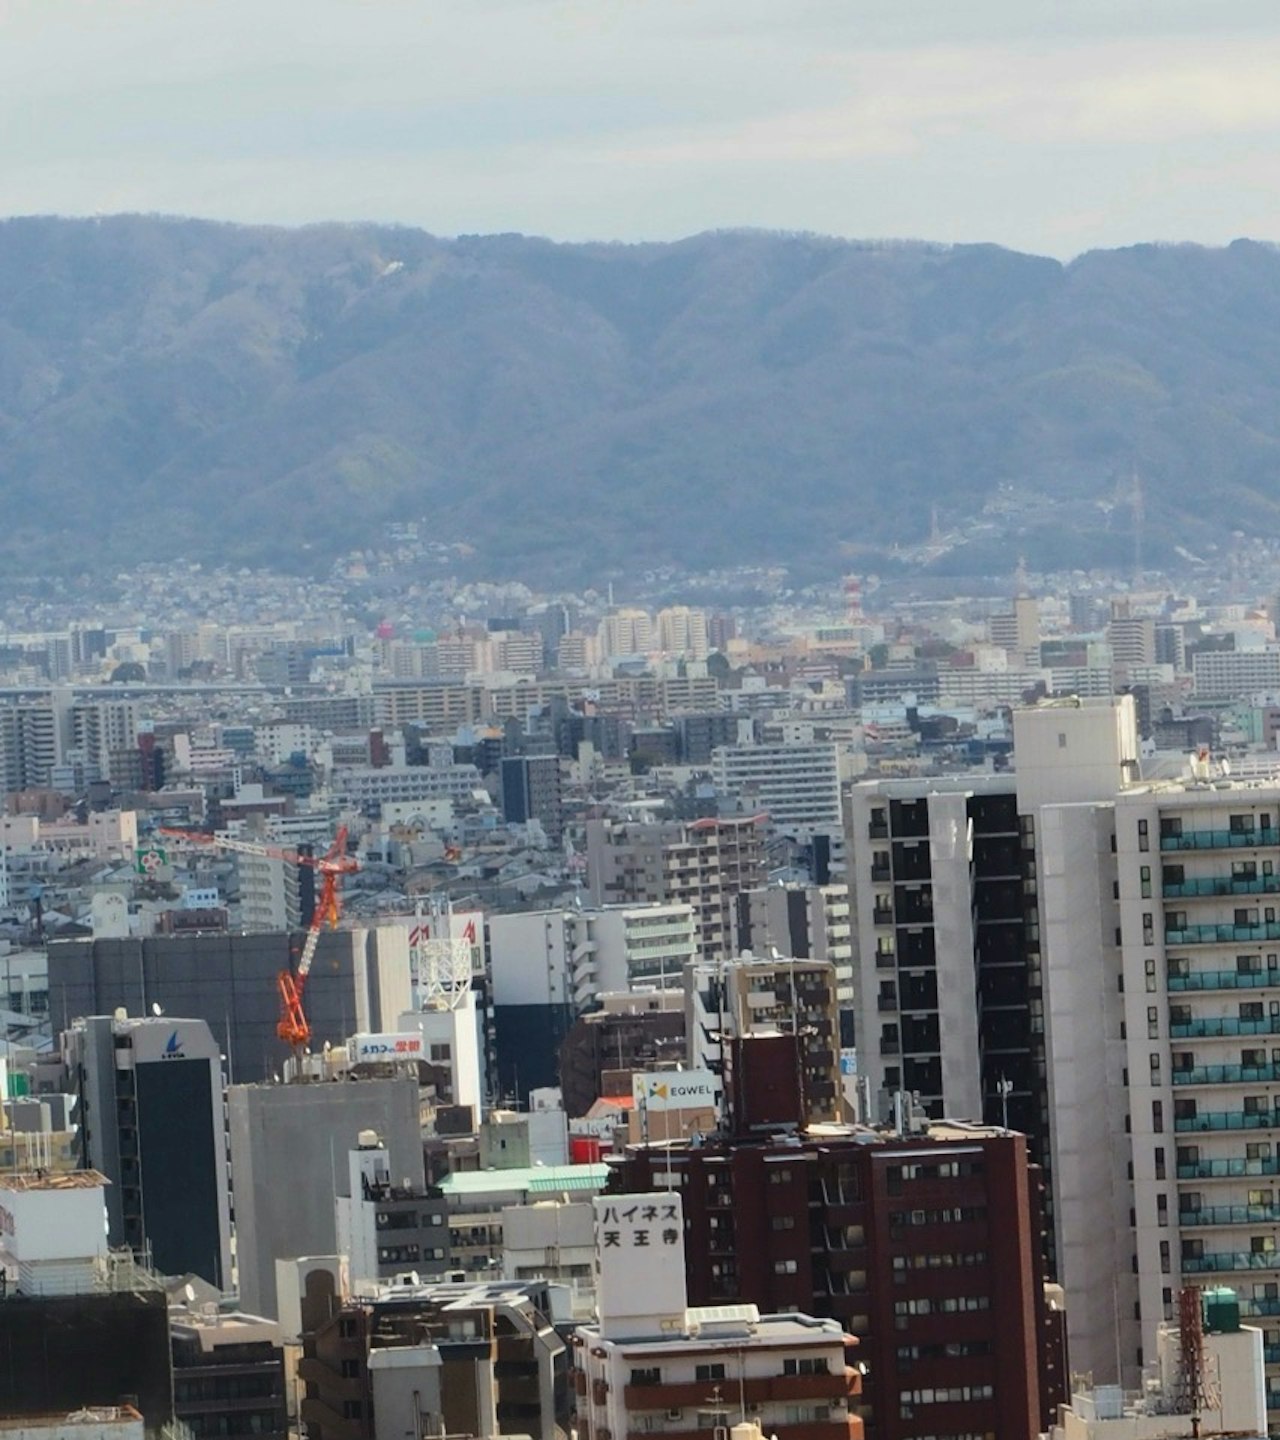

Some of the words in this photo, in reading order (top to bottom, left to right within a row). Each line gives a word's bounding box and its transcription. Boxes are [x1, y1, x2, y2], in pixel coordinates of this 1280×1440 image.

[670, 1085, 712, 1097] EQWEL
[602, 1204, 678, 1225] ハイネス
[603, 1227, 679, 1248] 天王寺
